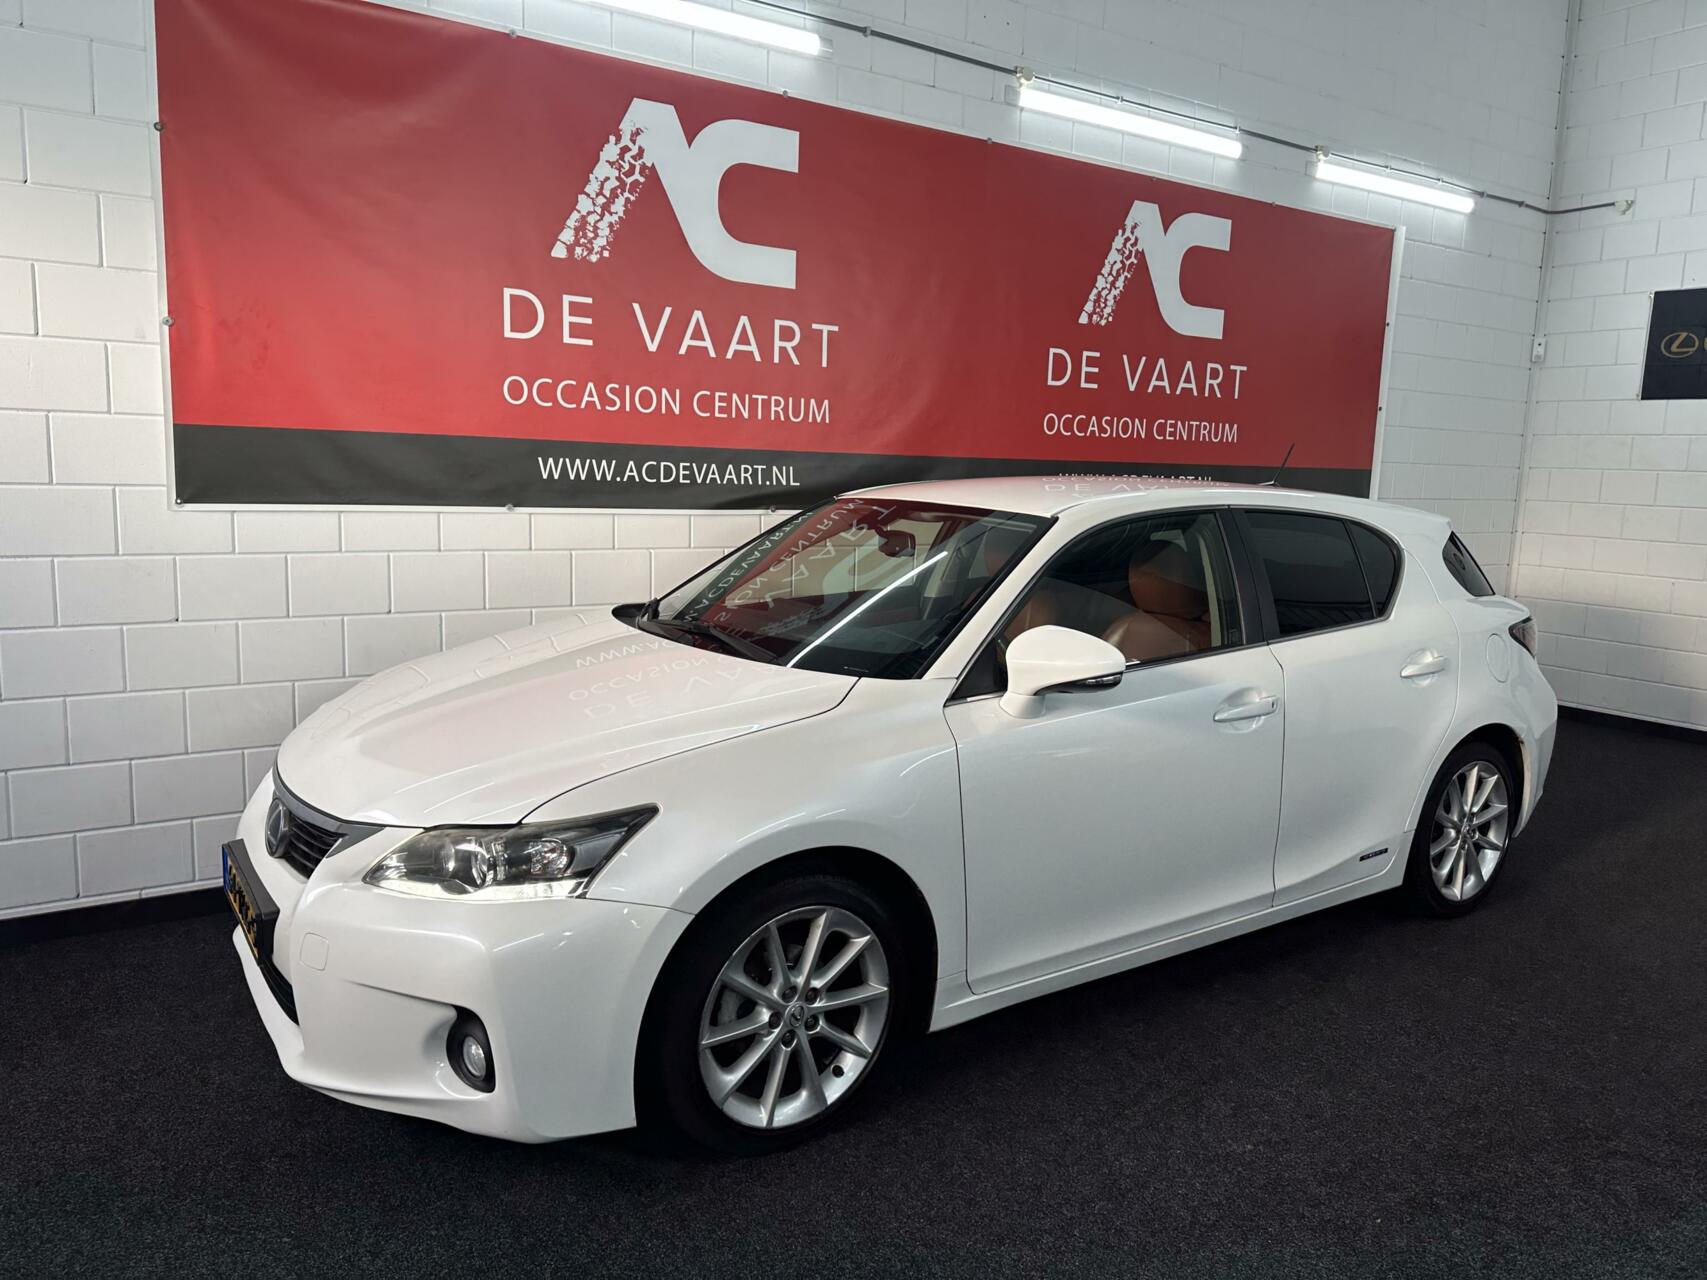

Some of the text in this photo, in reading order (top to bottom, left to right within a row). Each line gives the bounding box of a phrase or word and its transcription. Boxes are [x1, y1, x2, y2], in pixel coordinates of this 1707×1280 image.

[502, 287, 840, 368] DE VAART
[1046, 347, 1248, 399] DE VAART
[502, 375, 831, 424] OCCASION CENTRUM
[1043, 412, 1239, 443] OCCASION CENTRUM
[538, 456, 801, 487] WWW.ACDEVAART.NL
